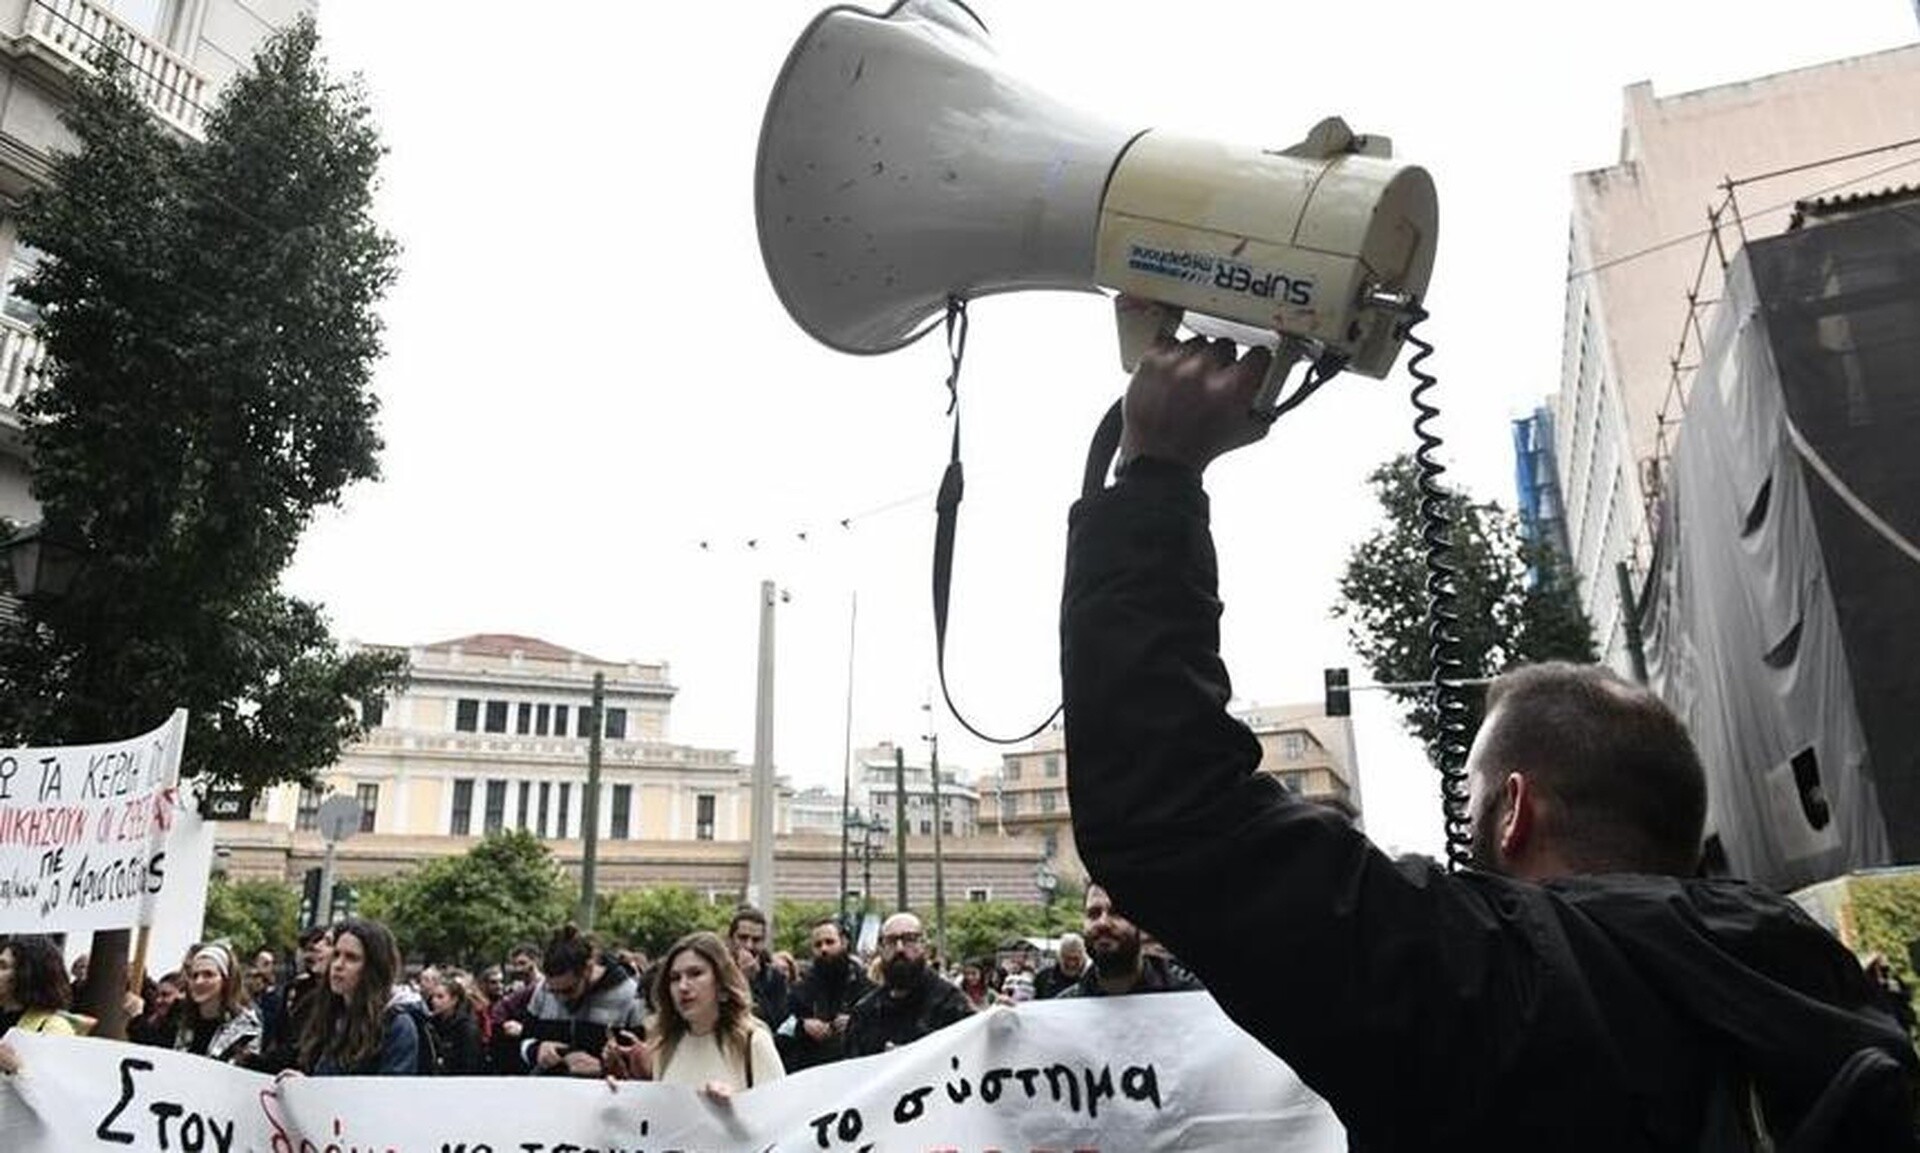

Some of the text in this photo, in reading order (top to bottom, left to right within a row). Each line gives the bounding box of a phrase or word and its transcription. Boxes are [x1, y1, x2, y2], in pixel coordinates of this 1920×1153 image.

[1213, 263, 1313, 306] SUPER
[810, 1108, 864, 1149] το
[893, 1056, 1163, 1119] σύστημα
